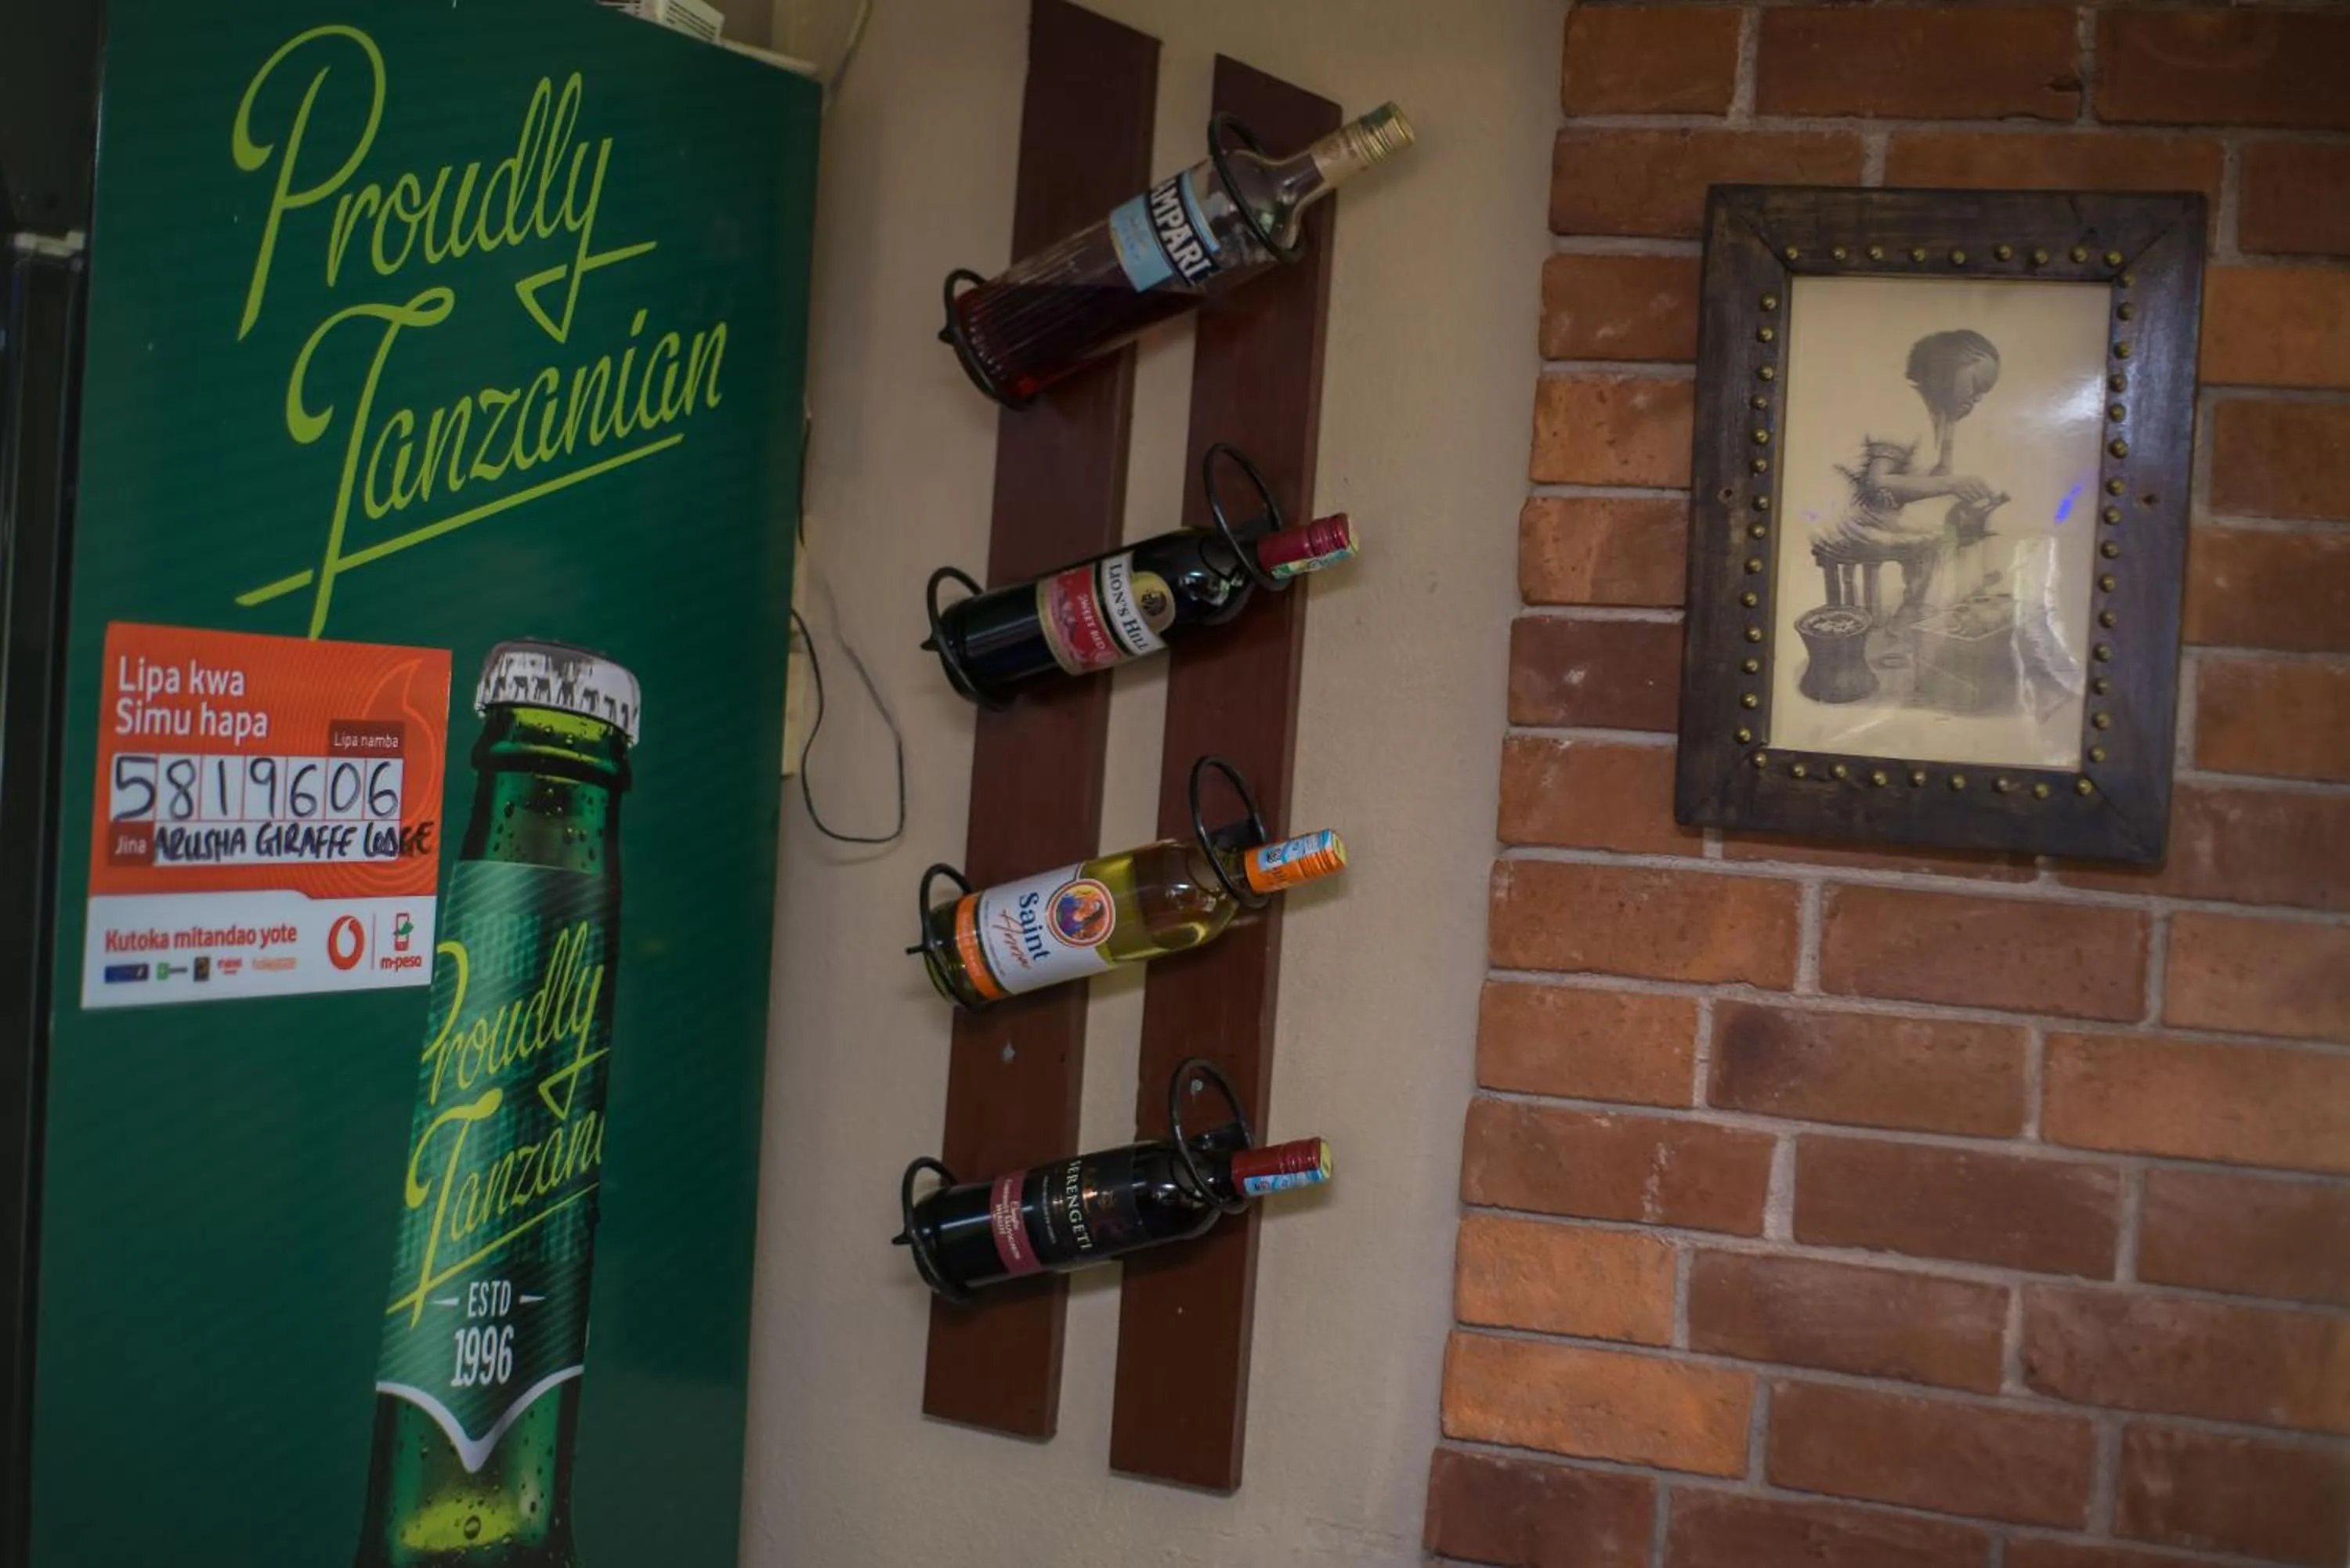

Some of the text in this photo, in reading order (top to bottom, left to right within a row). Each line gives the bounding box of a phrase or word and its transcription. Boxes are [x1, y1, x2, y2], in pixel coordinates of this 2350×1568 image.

[232, 25, 656, 344] Proudly
[236, 287, 727, 640] Tanzanian
[118, 656, 244, 701] Lipa kwa
[115, 699, 268, 746] Simu hapa
[334, 732, 399, 748] Lipa namba
[113, 756, 398, 821] 5819606
[114, 835, 146, 854] Jina
[155, 825, 247, 862] ARUSHA
[256, 821, 357, 858] GIRAFFE
[104, 924, 297, 952] Kutoka mitandao yote
[1019, 892, 1050, 960] Saint
[467, 1280, 512, 1317] ESTD
[450, 1324, 515, 1387] 1996
